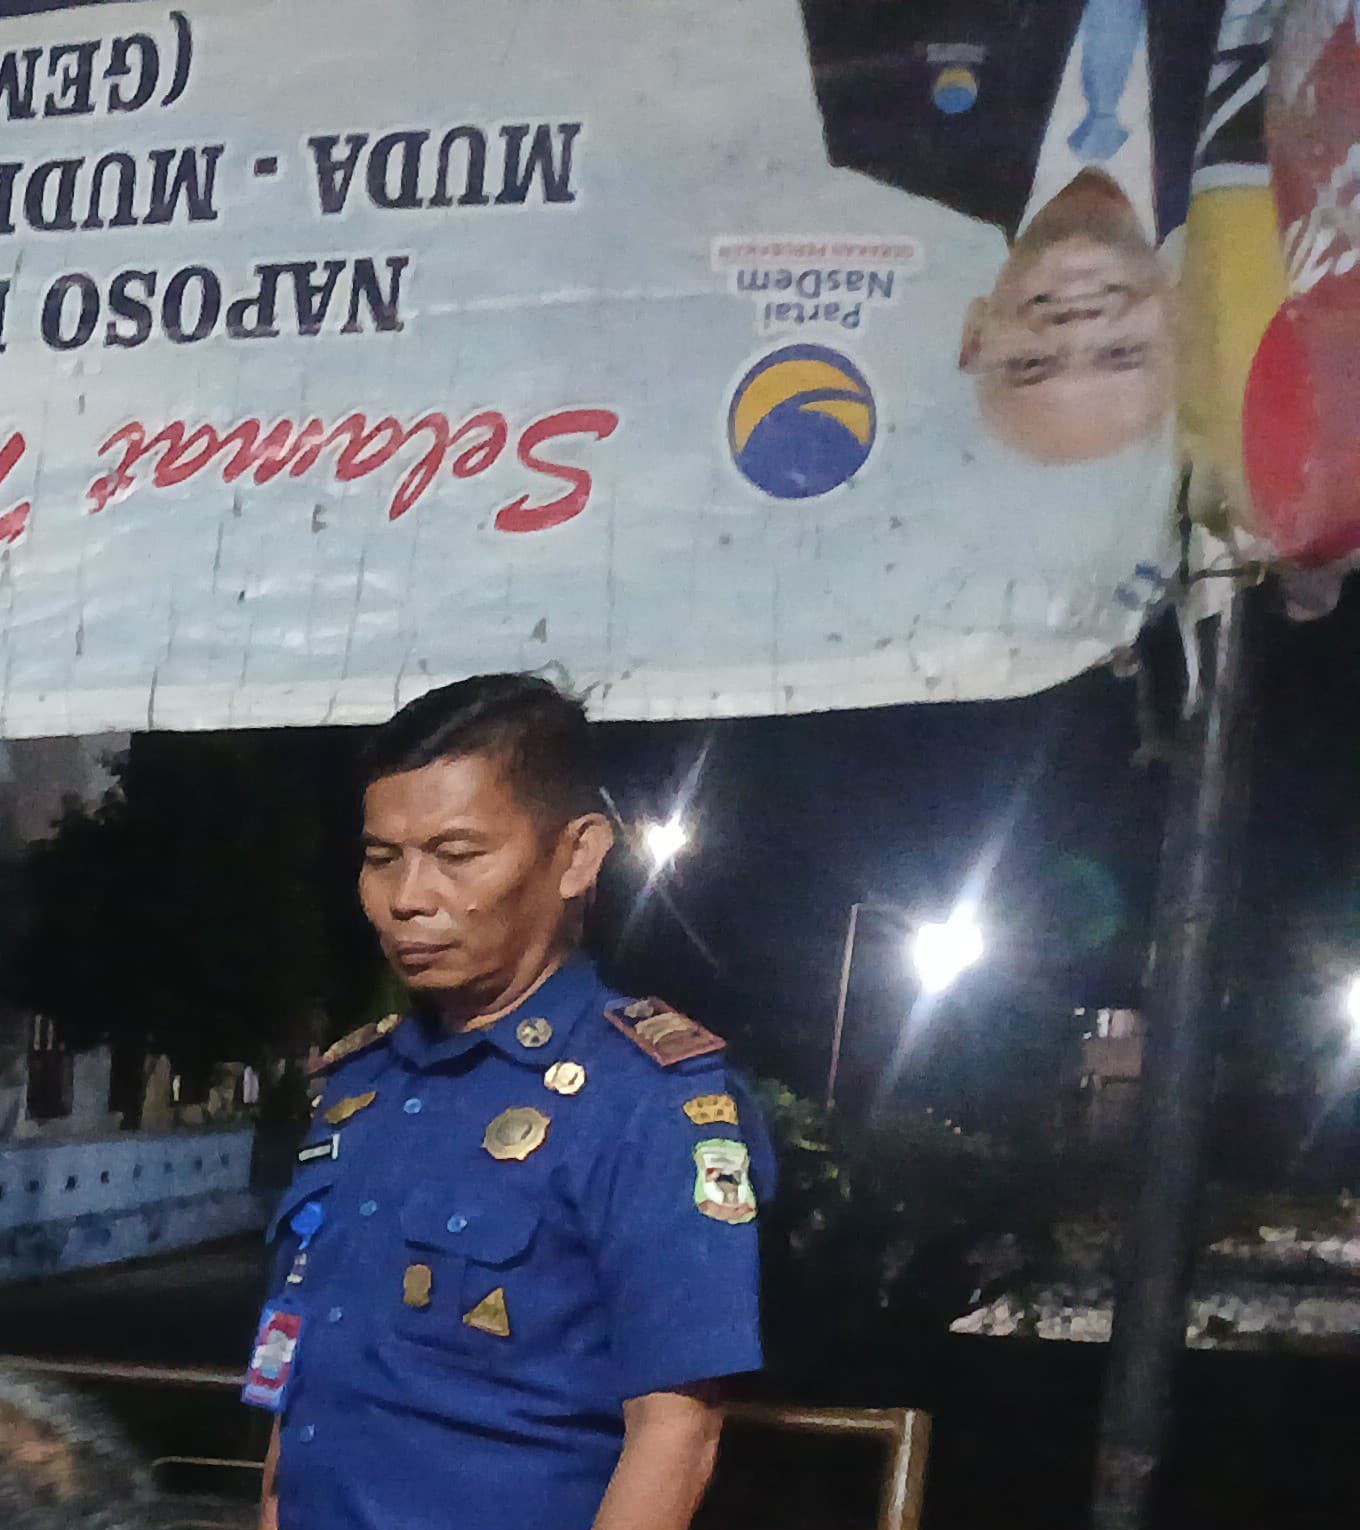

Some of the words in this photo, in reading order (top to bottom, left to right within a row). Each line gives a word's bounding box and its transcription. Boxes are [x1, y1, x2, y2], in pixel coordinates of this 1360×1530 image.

[254, 156, 277, 178] -
[307, 122, 582, 215] MUDA
[40, 255, 408, 352] NAPOSO
[736, 269, 895, 300] NasDem
[763, 301, 861, 331] Partai
[85, 409, 619, 533] Selamat
